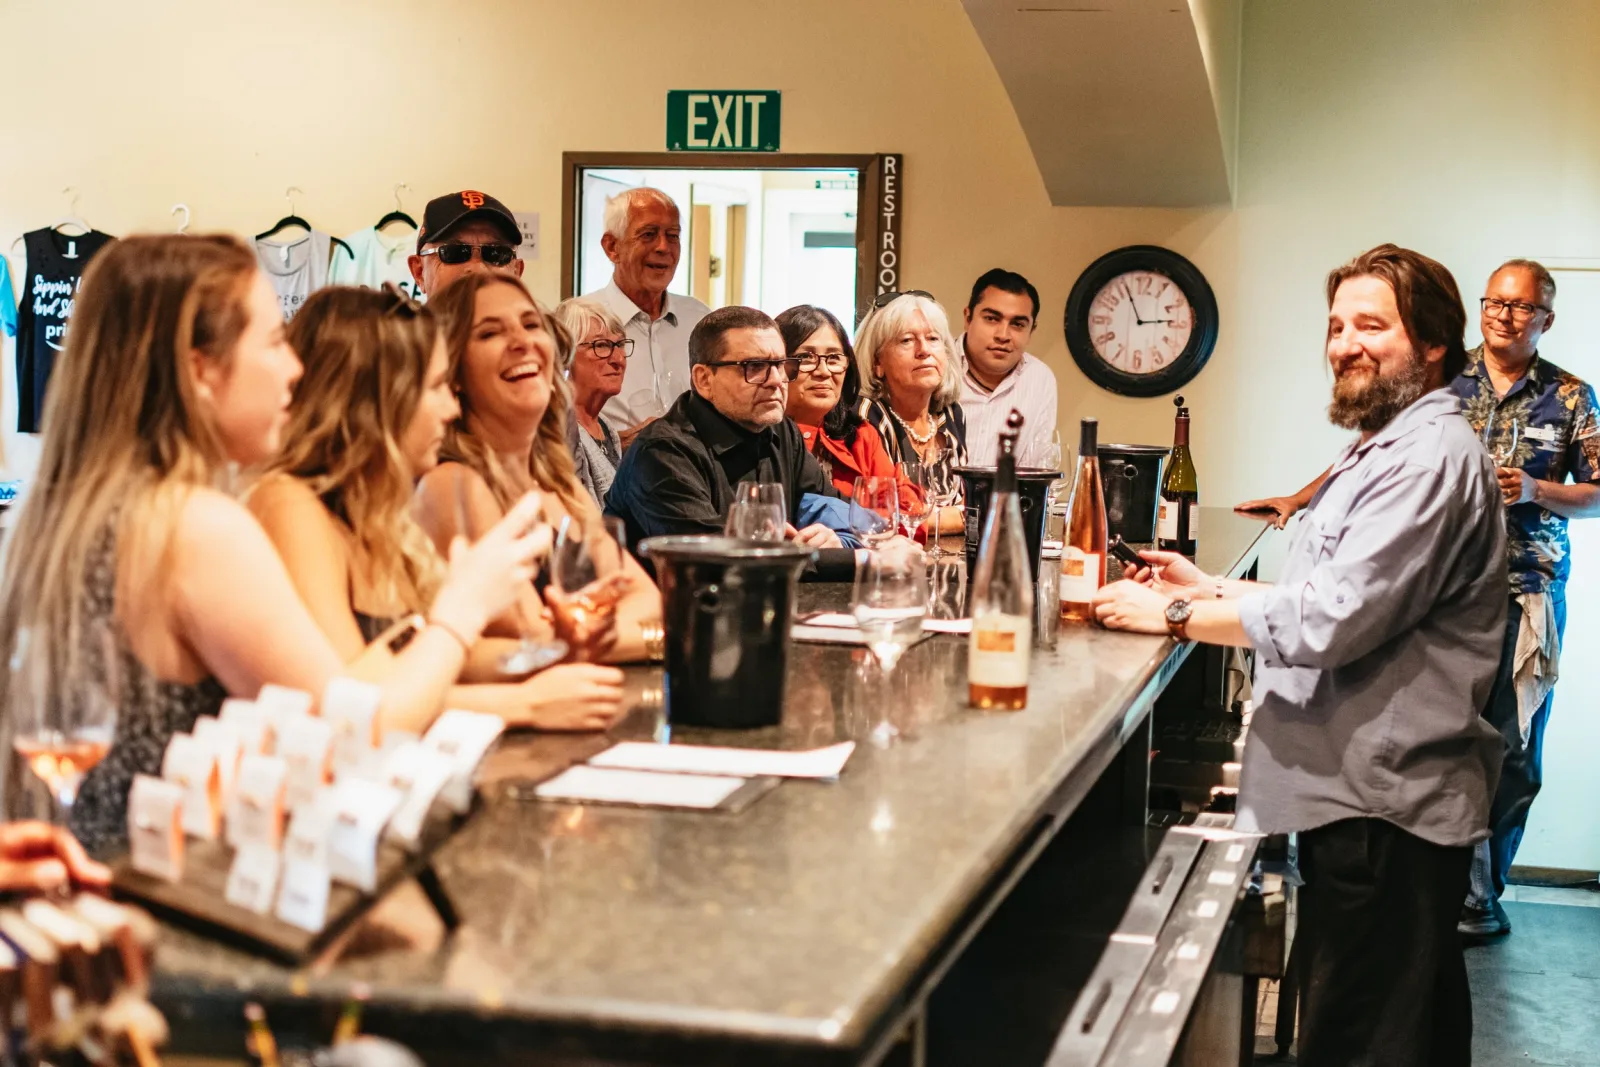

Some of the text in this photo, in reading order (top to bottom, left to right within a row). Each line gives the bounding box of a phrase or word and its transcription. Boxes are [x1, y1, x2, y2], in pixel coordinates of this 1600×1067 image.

[687, 94, 767, 147] EXIT
[1135, 276, 1153, 295] 12
[33, 296, 61, 316] And
[1164, 298, 1185, 314] 2
[1091, 315, 1112, 325] 9
[1096, 331, 1115, 345] 8
[1112, 343, 1126, 361] 7
[1133, 349, 1142, 369] 6
[1150, 346, 1164, 365] 5
